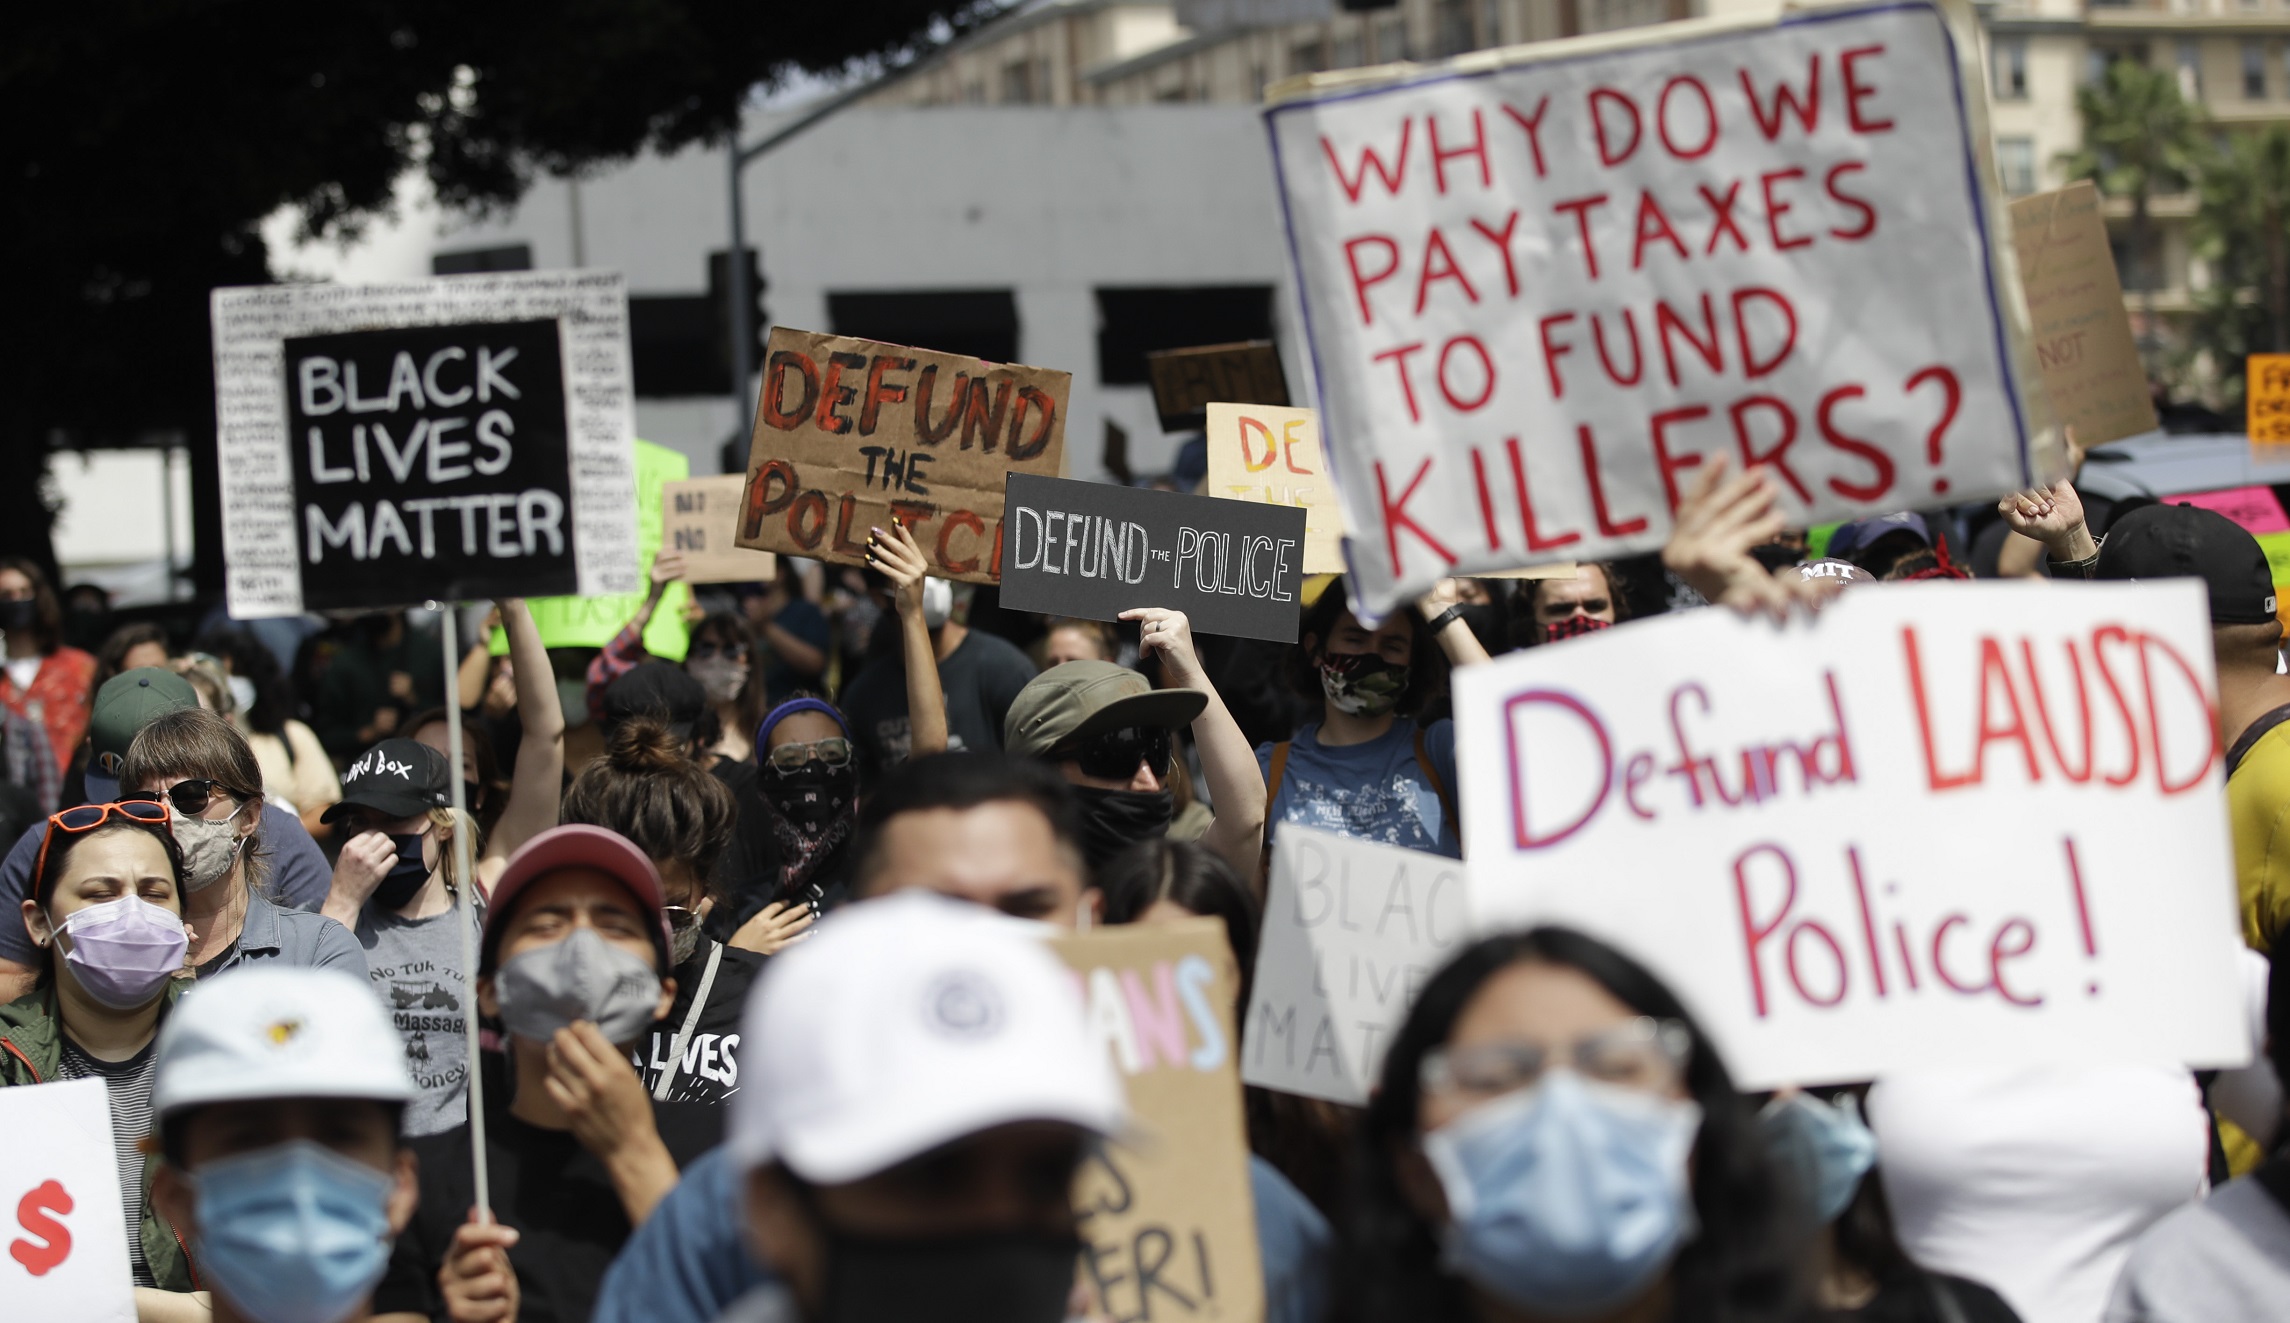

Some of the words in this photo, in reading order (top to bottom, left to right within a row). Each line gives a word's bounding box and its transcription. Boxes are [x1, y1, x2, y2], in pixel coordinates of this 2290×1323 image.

[1320, 96, 1550, 205] WHY
[1587, 74, 1719, 168] DO
[1739, 45, 1894, 140] WE
[1342, 210, 1520, 326] PAY
[1554, 161, 1877, 280] TAXES
[299, 346, 521, 416] BLACK
[1372, 334, 1496, 422] TO
[1539, 286, 1798, 398] FUND
[2037, 331, 2085, 370] NOT
[308, 409, 514, 484] LIVES
[763, 351, 1056, 461] DEFUND
[742, 460, 1005, 582] POLIC
[859, 446, 936, 495] THE
[1373, 365, 1962, 579] KILLERS?
[305, 489, 564, 564] MATTER
[1014, 506, 1149, 584] DEFUND
[1151, 549, 1171, 562] THE
[1174, 527, 1295, 602] POLICE
[1801, 562, 1854, 583] MIT
[1502, 668, 1860, 851] Defund
[1901, 623, 2222, 797] LAUSD
[1293, 838, 1463, 949] BLAC
[1732, 834, 2102, 1019] Police!
[370, 967, 395, 981] No
[443, 967, 466, 981] TU
[394, 1012, 466, 1034] Massag
[1067, 955, 1228, 1076] ANS
[1313, 950, 1430, 1010] LIVE
